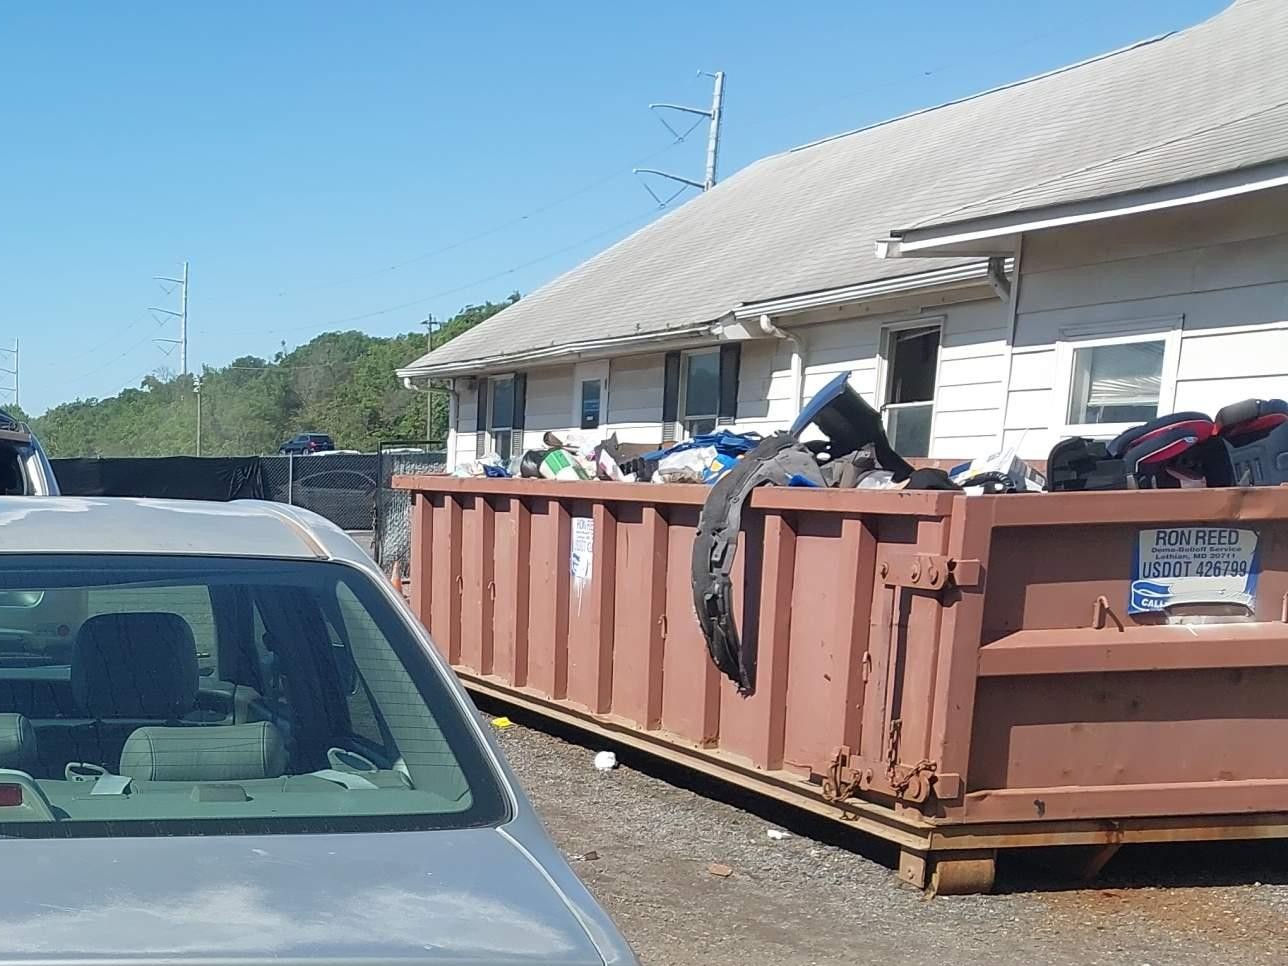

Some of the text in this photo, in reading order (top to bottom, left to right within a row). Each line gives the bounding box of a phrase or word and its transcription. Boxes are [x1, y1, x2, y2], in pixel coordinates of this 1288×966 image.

[1155, 530, 1239, 546] RON REED
[1142, 560, 1247, 578] USDOT 426799
